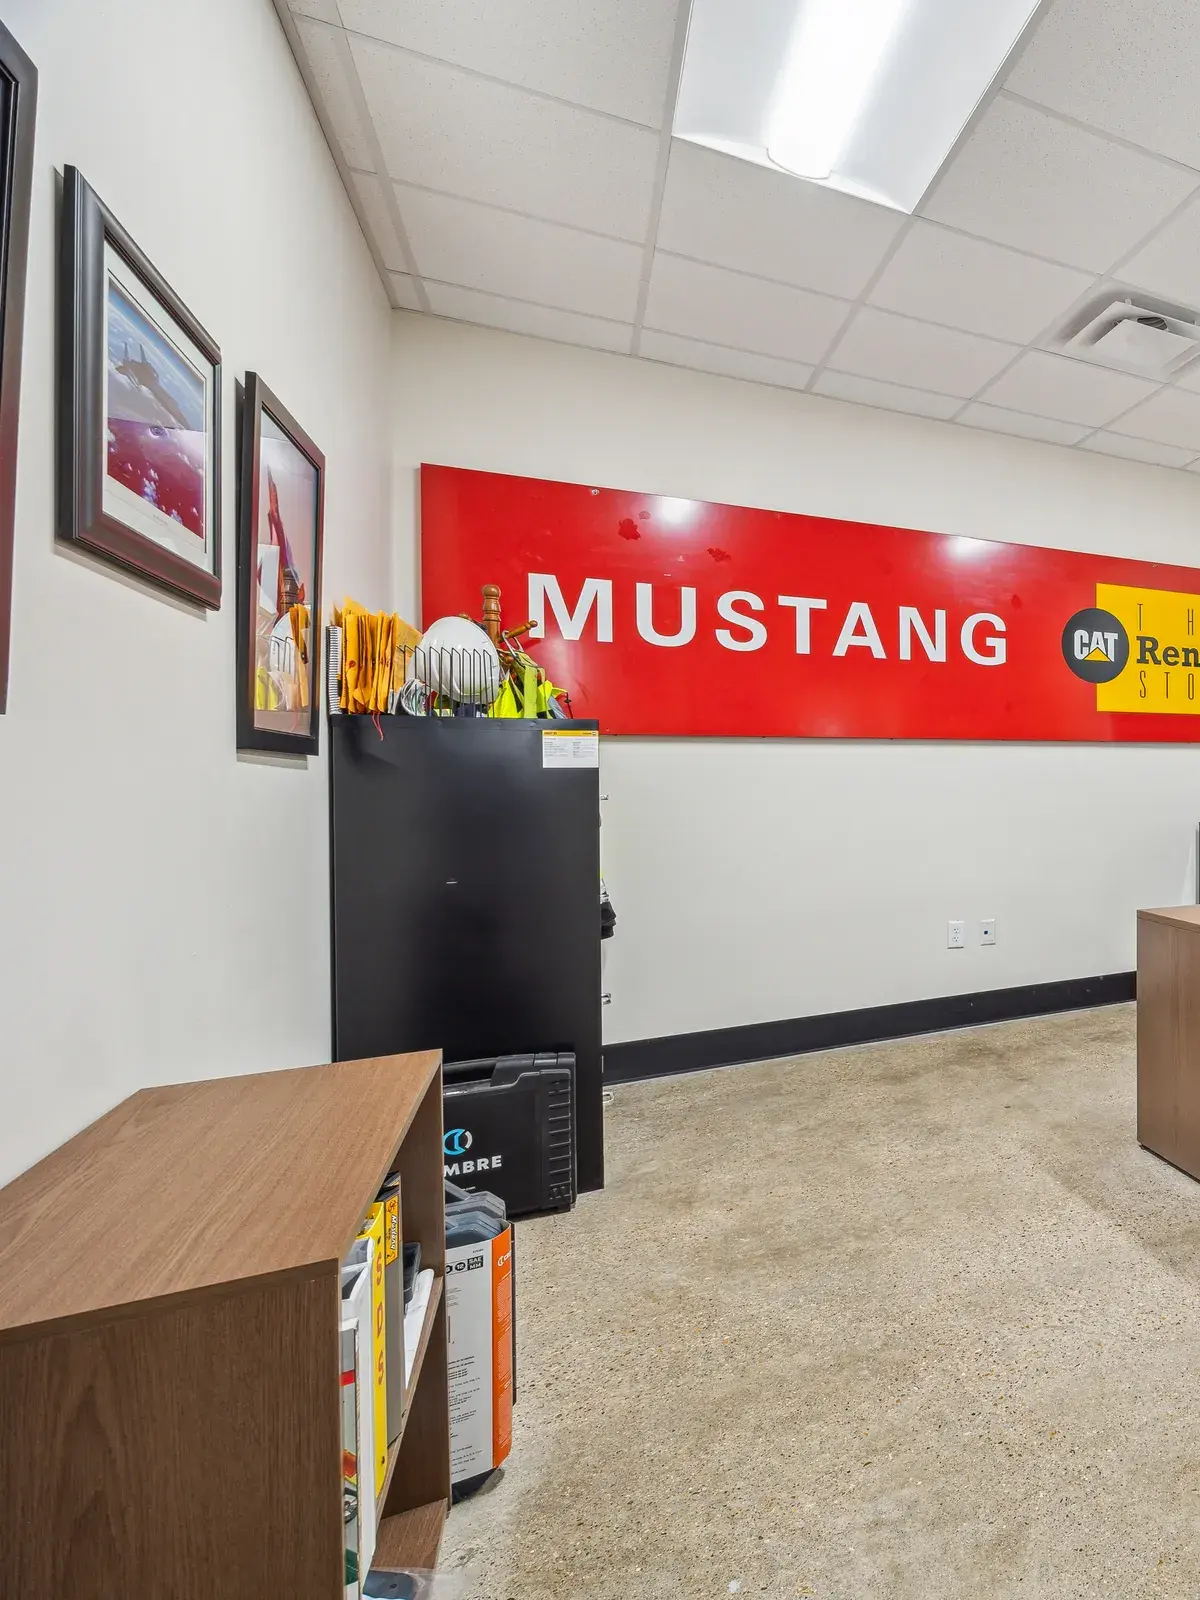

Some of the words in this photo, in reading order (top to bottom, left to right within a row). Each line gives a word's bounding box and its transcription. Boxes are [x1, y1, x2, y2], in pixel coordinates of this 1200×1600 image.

[527, 572, 1007, 666] MUSTANG
[1073, 629, 1119, 662] CAT
[443, 1154, 502, 1178] MBRE
[390, 1213, 398, 1251] Mustang
[468, 1256, 483, 1264] SAE
[469, 1262, 482, 1270] MM
